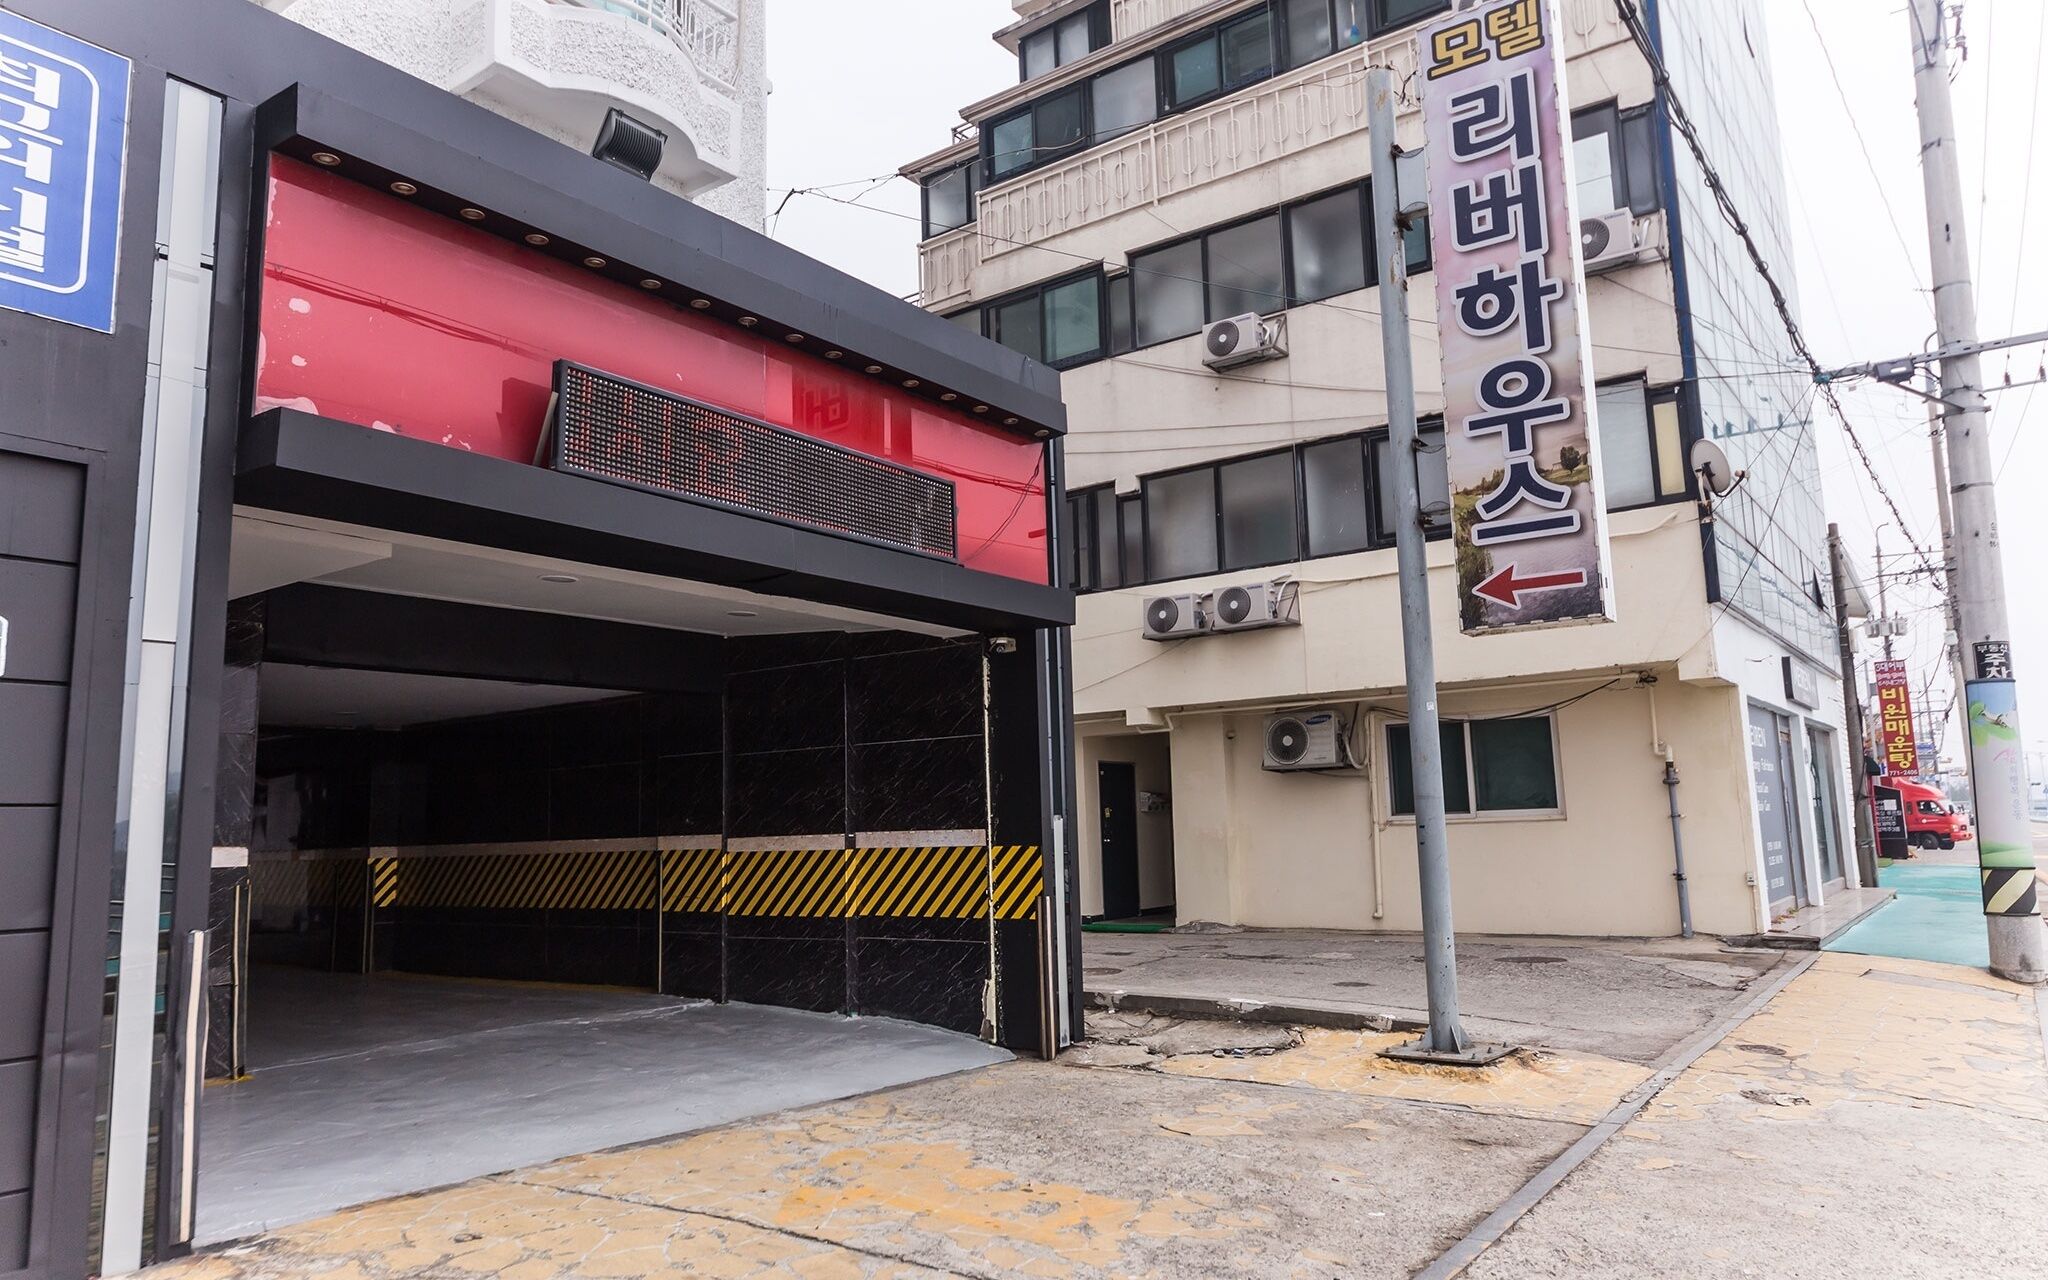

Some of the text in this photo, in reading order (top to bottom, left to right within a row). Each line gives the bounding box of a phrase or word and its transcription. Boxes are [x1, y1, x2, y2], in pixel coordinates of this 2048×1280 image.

[1427, 0, 1546, 81] 모텔
[1447, 68, 1580, 546] 리버하우스
[1881, 686, 1915, 769] 비원매운탕
